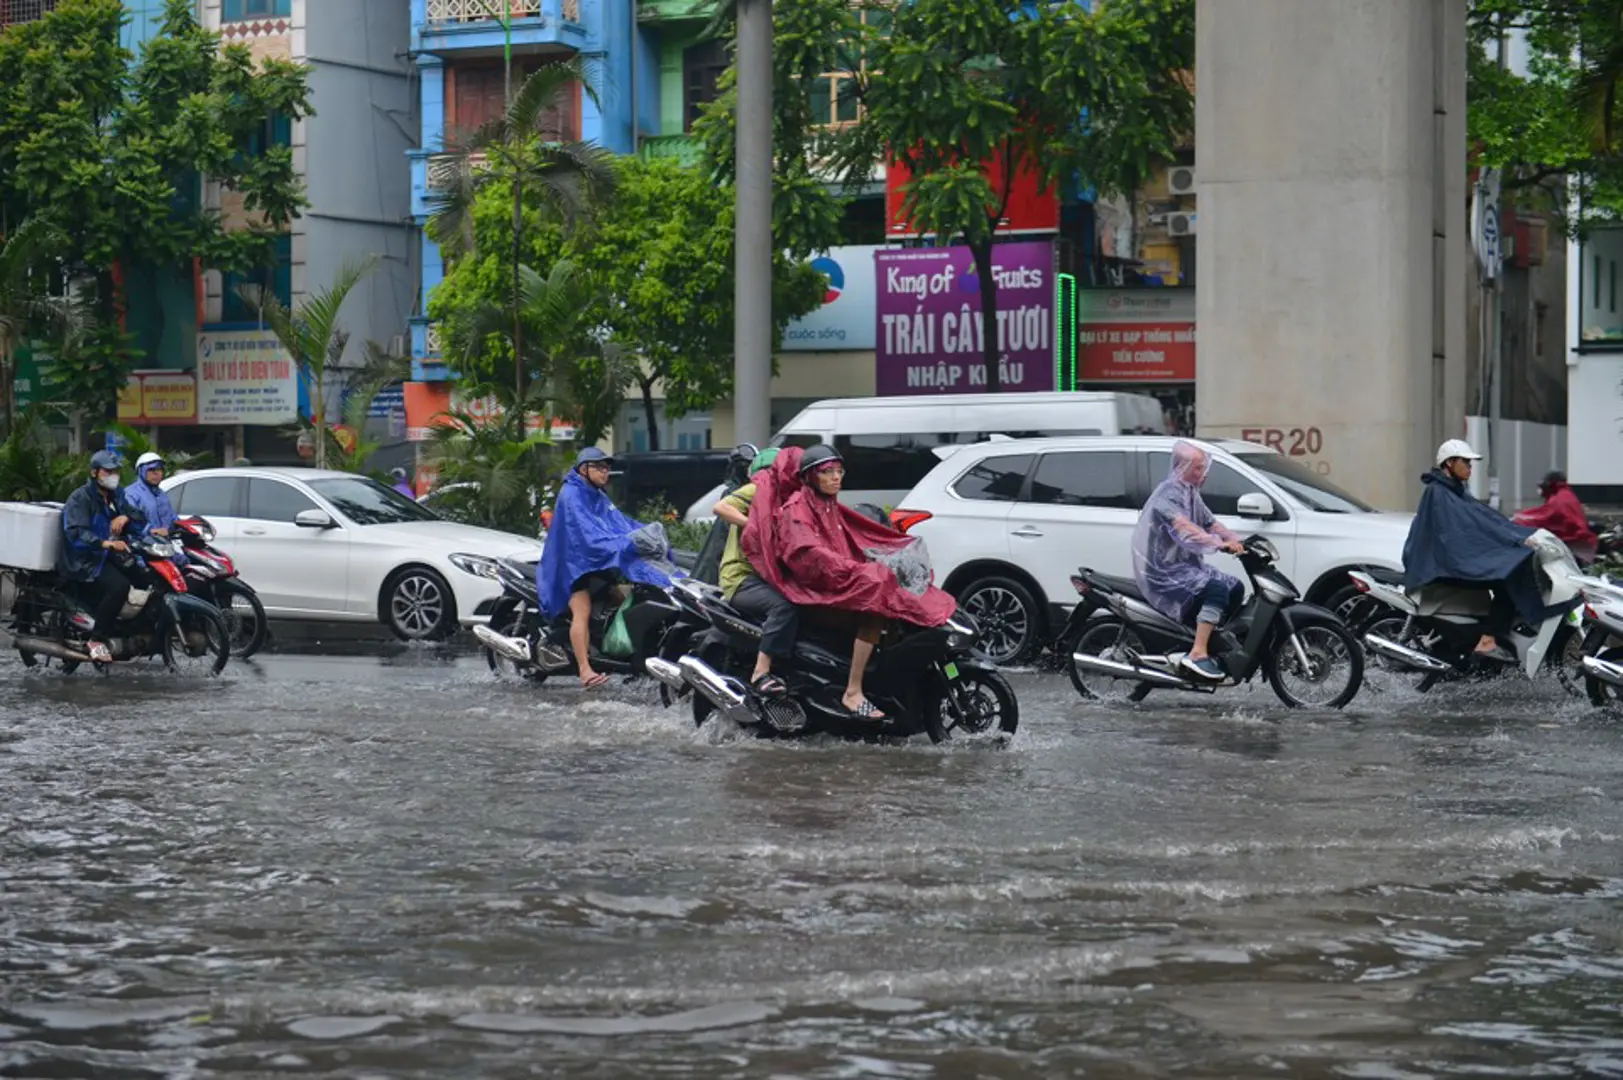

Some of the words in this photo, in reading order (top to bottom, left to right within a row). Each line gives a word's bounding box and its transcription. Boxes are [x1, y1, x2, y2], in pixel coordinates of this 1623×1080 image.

[887, 266, 927, 300] King
[930, 264, 954, 294] of
[991, 265, 1043, 290] Fruits
[818, 326, 846, 341] sống
[882, 304, 935, 355] TRÁI
[942, 303, 985, 353] CÂY
[995, 304, 1049, 351] TƯƠI
[907, 361, 962, 390] NHẬP
